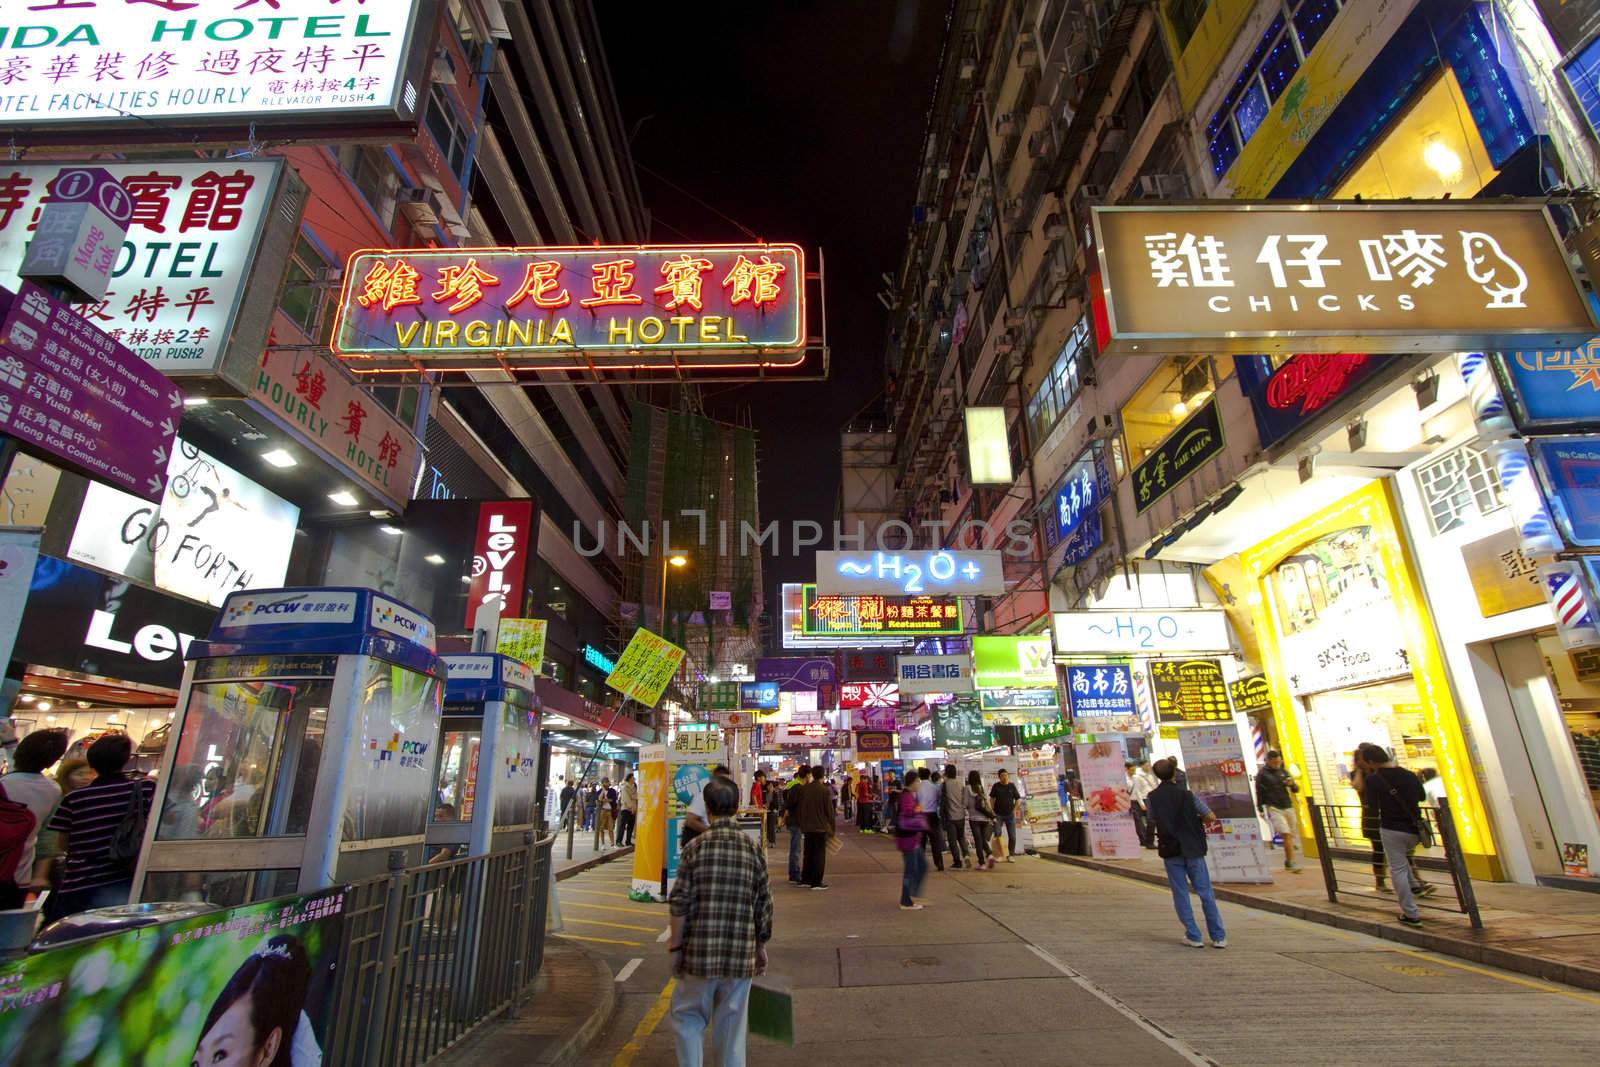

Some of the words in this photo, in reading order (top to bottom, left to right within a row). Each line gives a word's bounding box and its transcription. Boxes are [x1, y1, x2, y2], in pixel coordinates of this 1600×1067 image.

[151, 14, 392, 42] HOTEL
[0, 94, 39, 113] TEL
[48, 90, 158, 111] FACILITIES
[167, 86, 252, 107] HOURLY
[74, 224, 104, 272] Mong
[356, 254, 786, 315] 維珍尼亞賓館
[1208, 294, 1416, 313] CHICKS
[68, 330, 97, 356] Yeung
[395, 318, 576, 348] VIRGINIA
[607, 315, 749, 345] HOTEL
[40, 353, 62, 374] Tung
[62, 367, 82, 384] Choi
[32, 371, 73, 401] 花園街
[27, 385, 41, 400] Fa
[45, 394, 72, 417] Yuen
[72, 409, 103, 432] Street
[256, 371, 329, 438] HOURLY
[346, 441, 389, 488] HOTEL
[13, 419, 44, 441] Mong
[46, 433, 66, 450] Kok
[66, 442, 110, 472] Computer
[121, 507, 169, 553] GO
[172, 534, 254, 592] FORTH
[254, 602, 302, 616] PCCW
[393, 614, 417, 632] PCCW
[401, 740, 428, 755] PCCW
